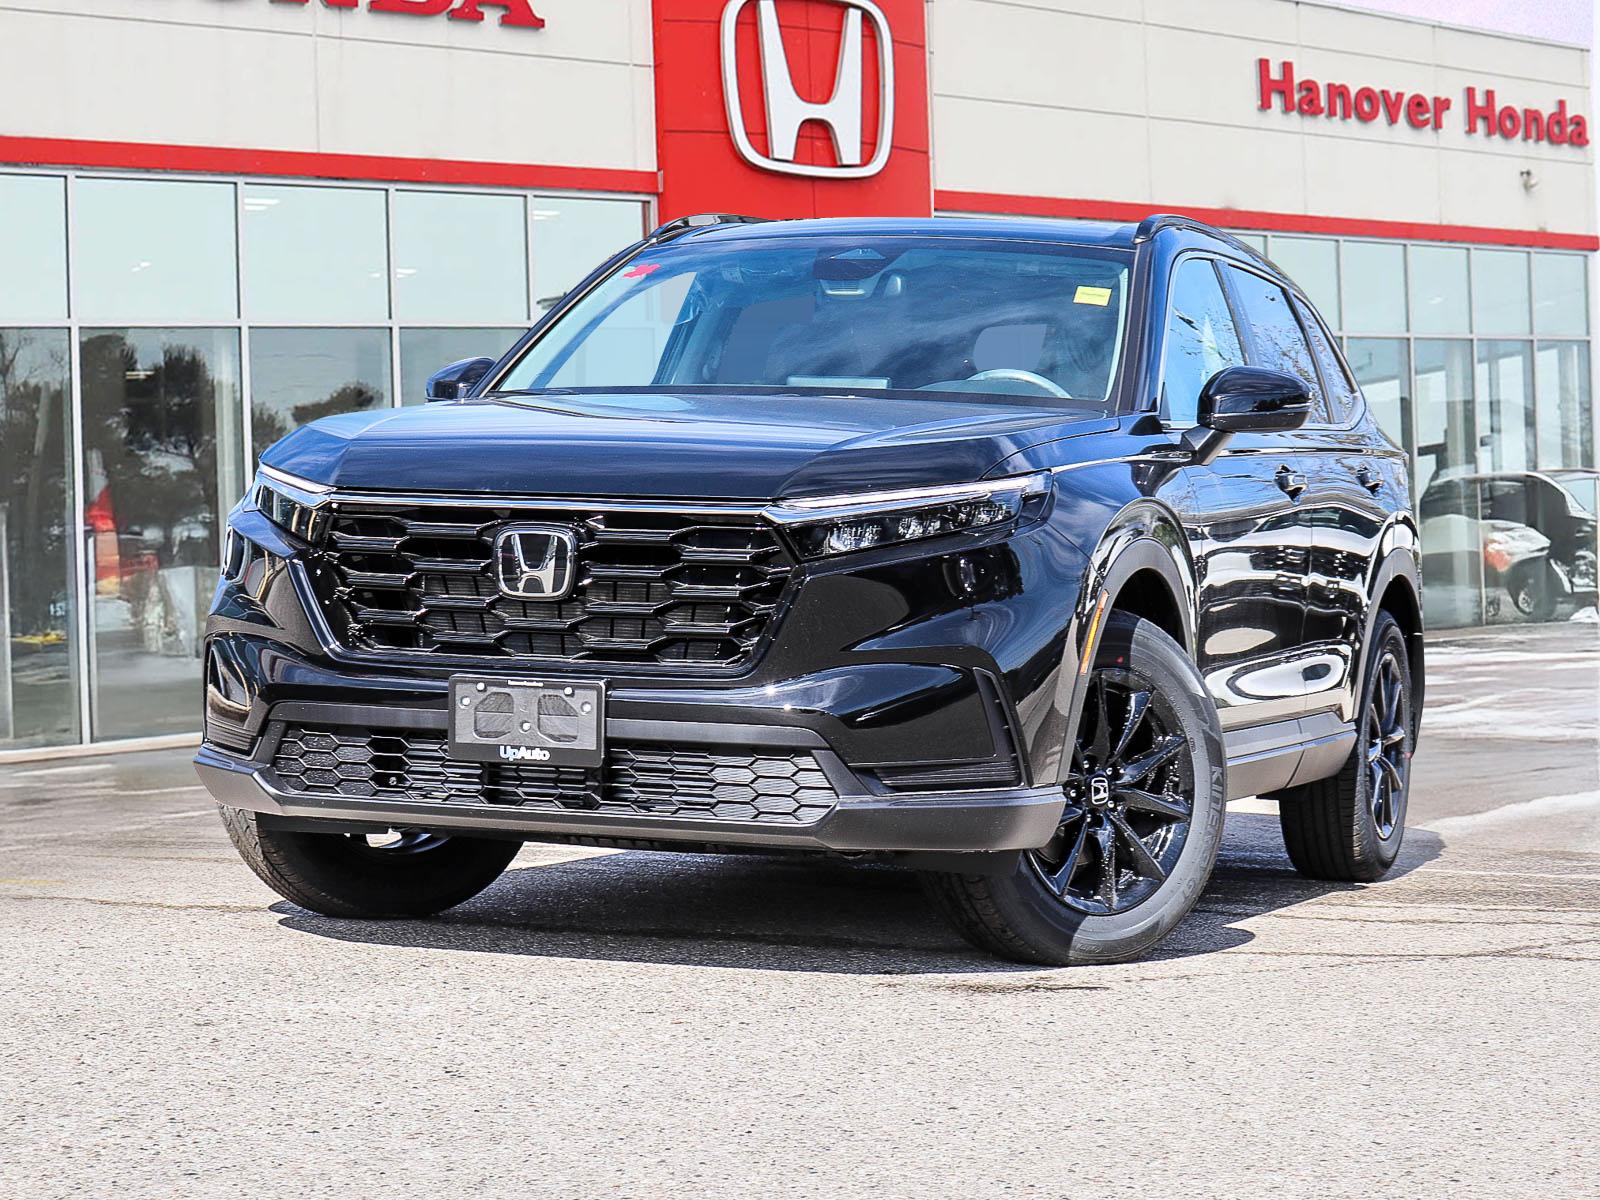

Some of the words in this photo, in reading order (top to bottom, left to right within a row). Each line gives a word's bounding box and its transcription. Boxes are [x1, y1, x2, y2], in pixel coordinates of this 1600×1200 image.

[1257, 57, 1452, 130] Hanover
[1464, 86, 1589, 148] Honda
[499, 744, 550, 761] UpAuto
